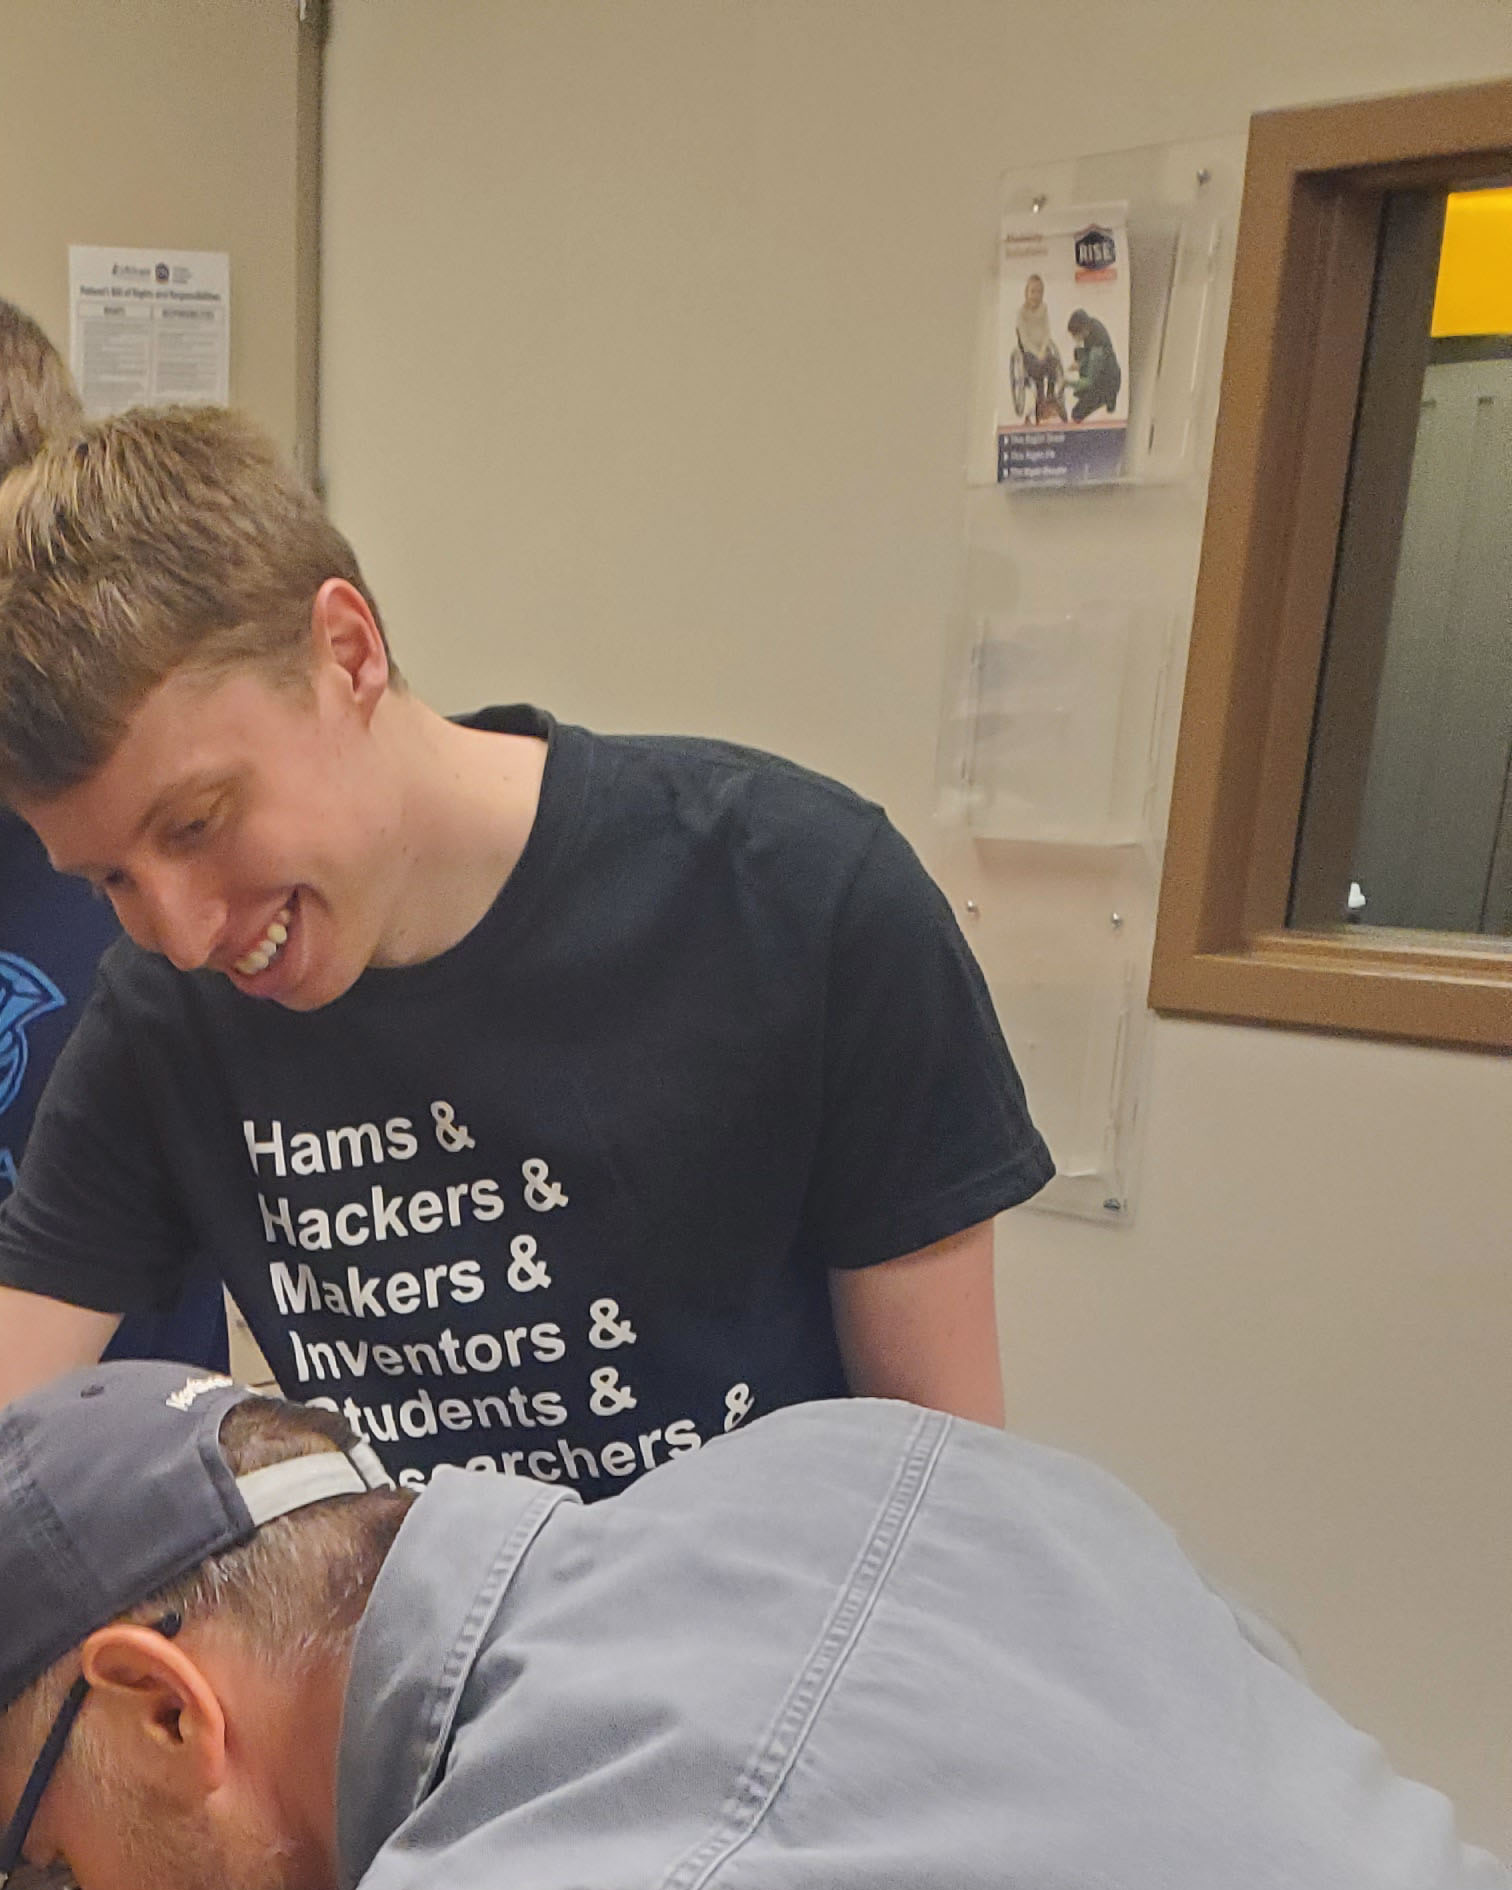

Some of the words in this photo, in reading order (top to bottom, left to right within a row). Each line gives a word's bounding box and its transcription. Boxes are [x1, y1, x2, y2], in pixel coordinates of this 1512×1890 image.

[244, 1118, 417, 1176] Hams
[431, 1101, 475, 1152] &
[259, 1179, 504, 1250] Hackers
[522, 1158, 568, 1212] &
[270, 1259, 484, 1318] Makers
[507, 1235, 551, 1292] &
[289, 1322, 565, 1383] Inventors
[589, 1298, 636, 1349] &
[589, 1366, 637, 1416] &
[724, 1382, 754, 1432] &
